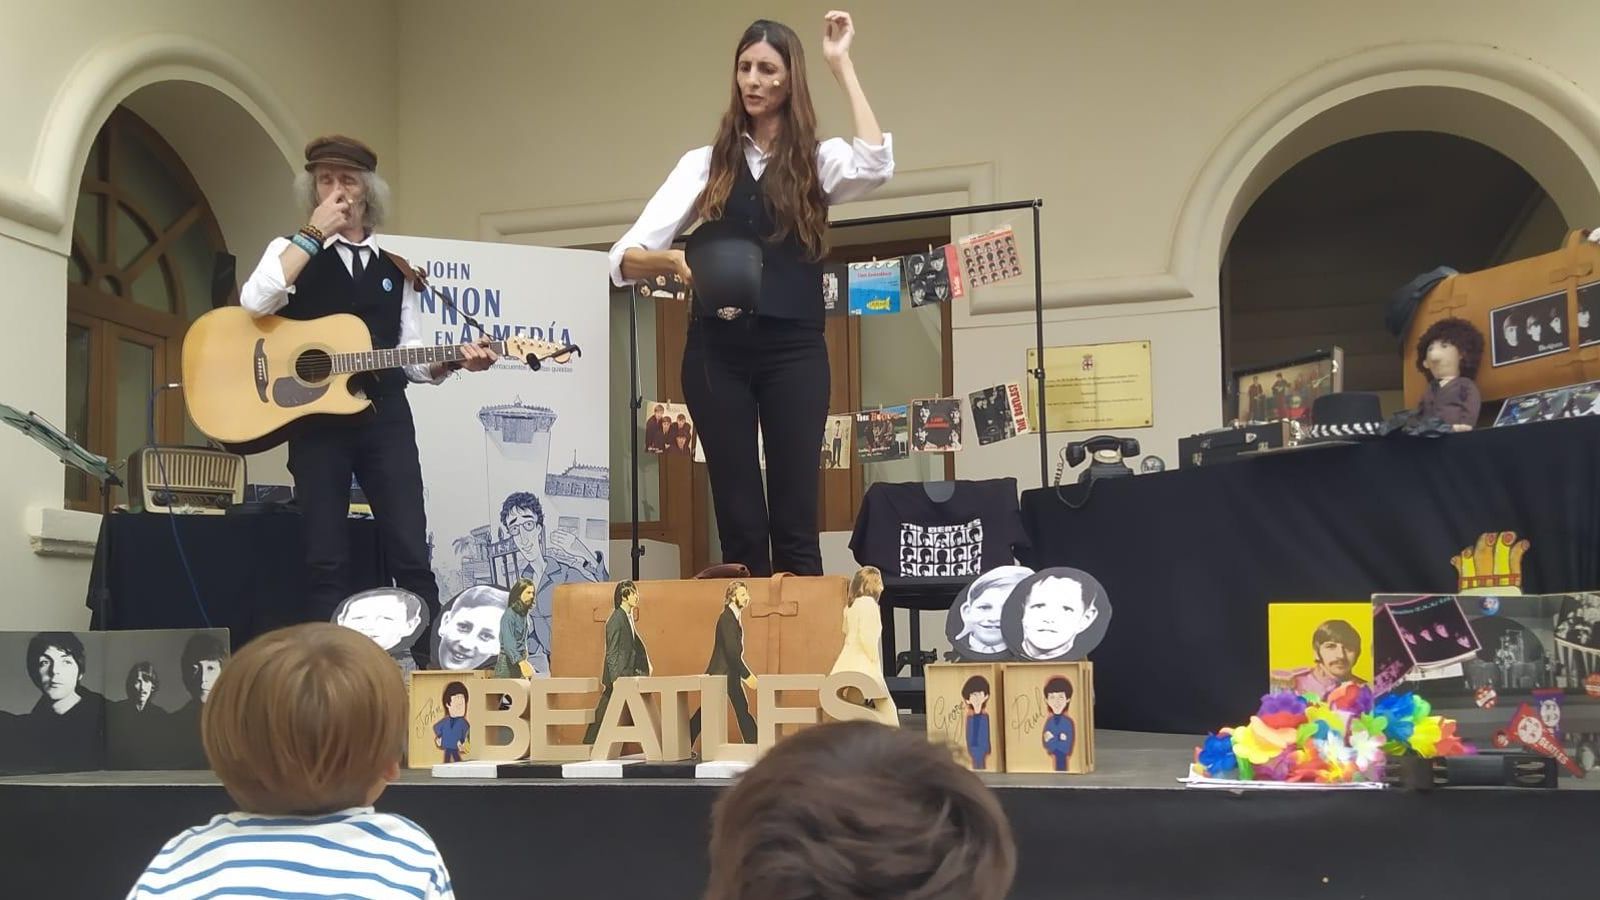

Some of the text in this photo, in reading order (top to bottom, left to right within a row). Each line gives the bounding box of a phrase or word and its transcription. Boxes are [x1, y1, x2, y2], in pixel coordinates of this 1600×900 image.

[426, 260, 471, 280] JOHN
[420, 285, 501, 326] NNON
[435, 330, 454, 345] EN
[901, 518, 982, 534] THE BEATLES
[470, 670, 889, 762] BEATLES
[1011, 686, 1045, 744] Paul
